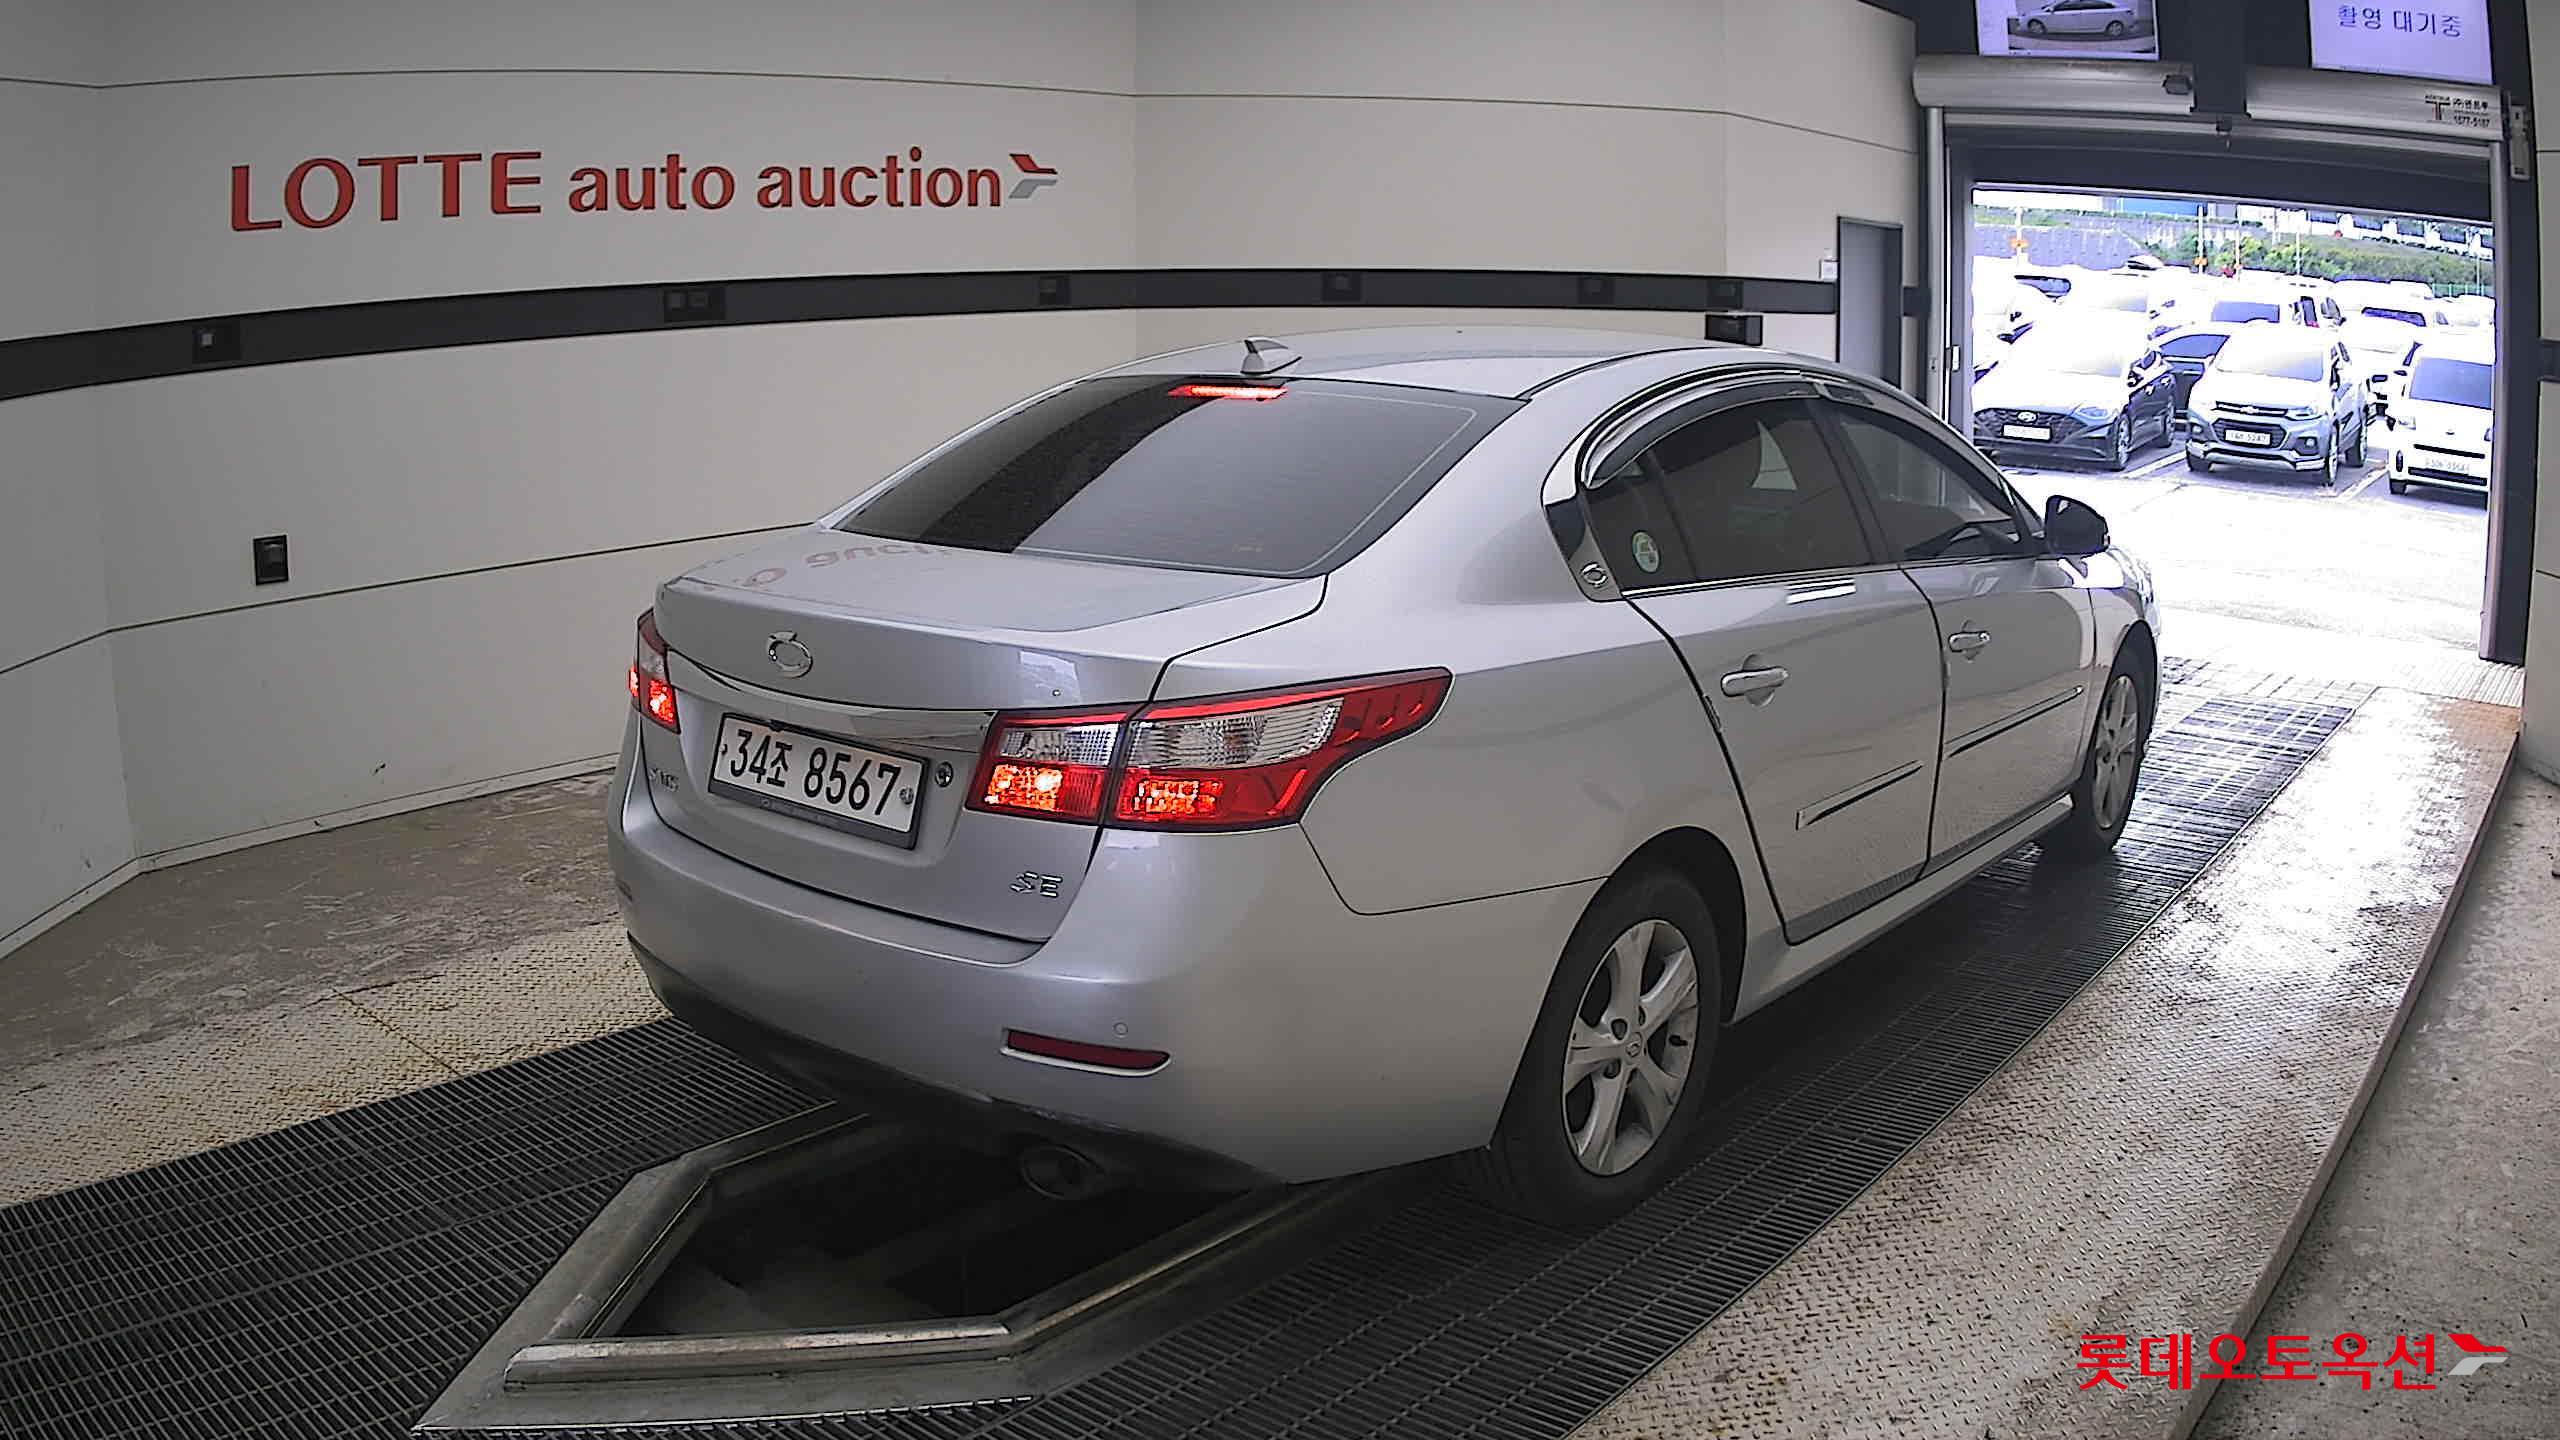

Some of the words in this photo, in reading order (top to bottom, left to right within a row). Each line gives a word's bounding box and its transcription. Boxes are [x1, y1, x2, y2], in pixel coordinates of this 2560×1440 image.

[2337, 4, 2382, 30] 촬영
[2392, 10, 2462, 38] 대기중
[231, 151, 542, 231] LOTTE
[568, 153, 736, 211] auto
[756, 147, 1002, 210] auction
[729, 728, 793, 788] 34조
[803, 746, 901, 816] 8567
